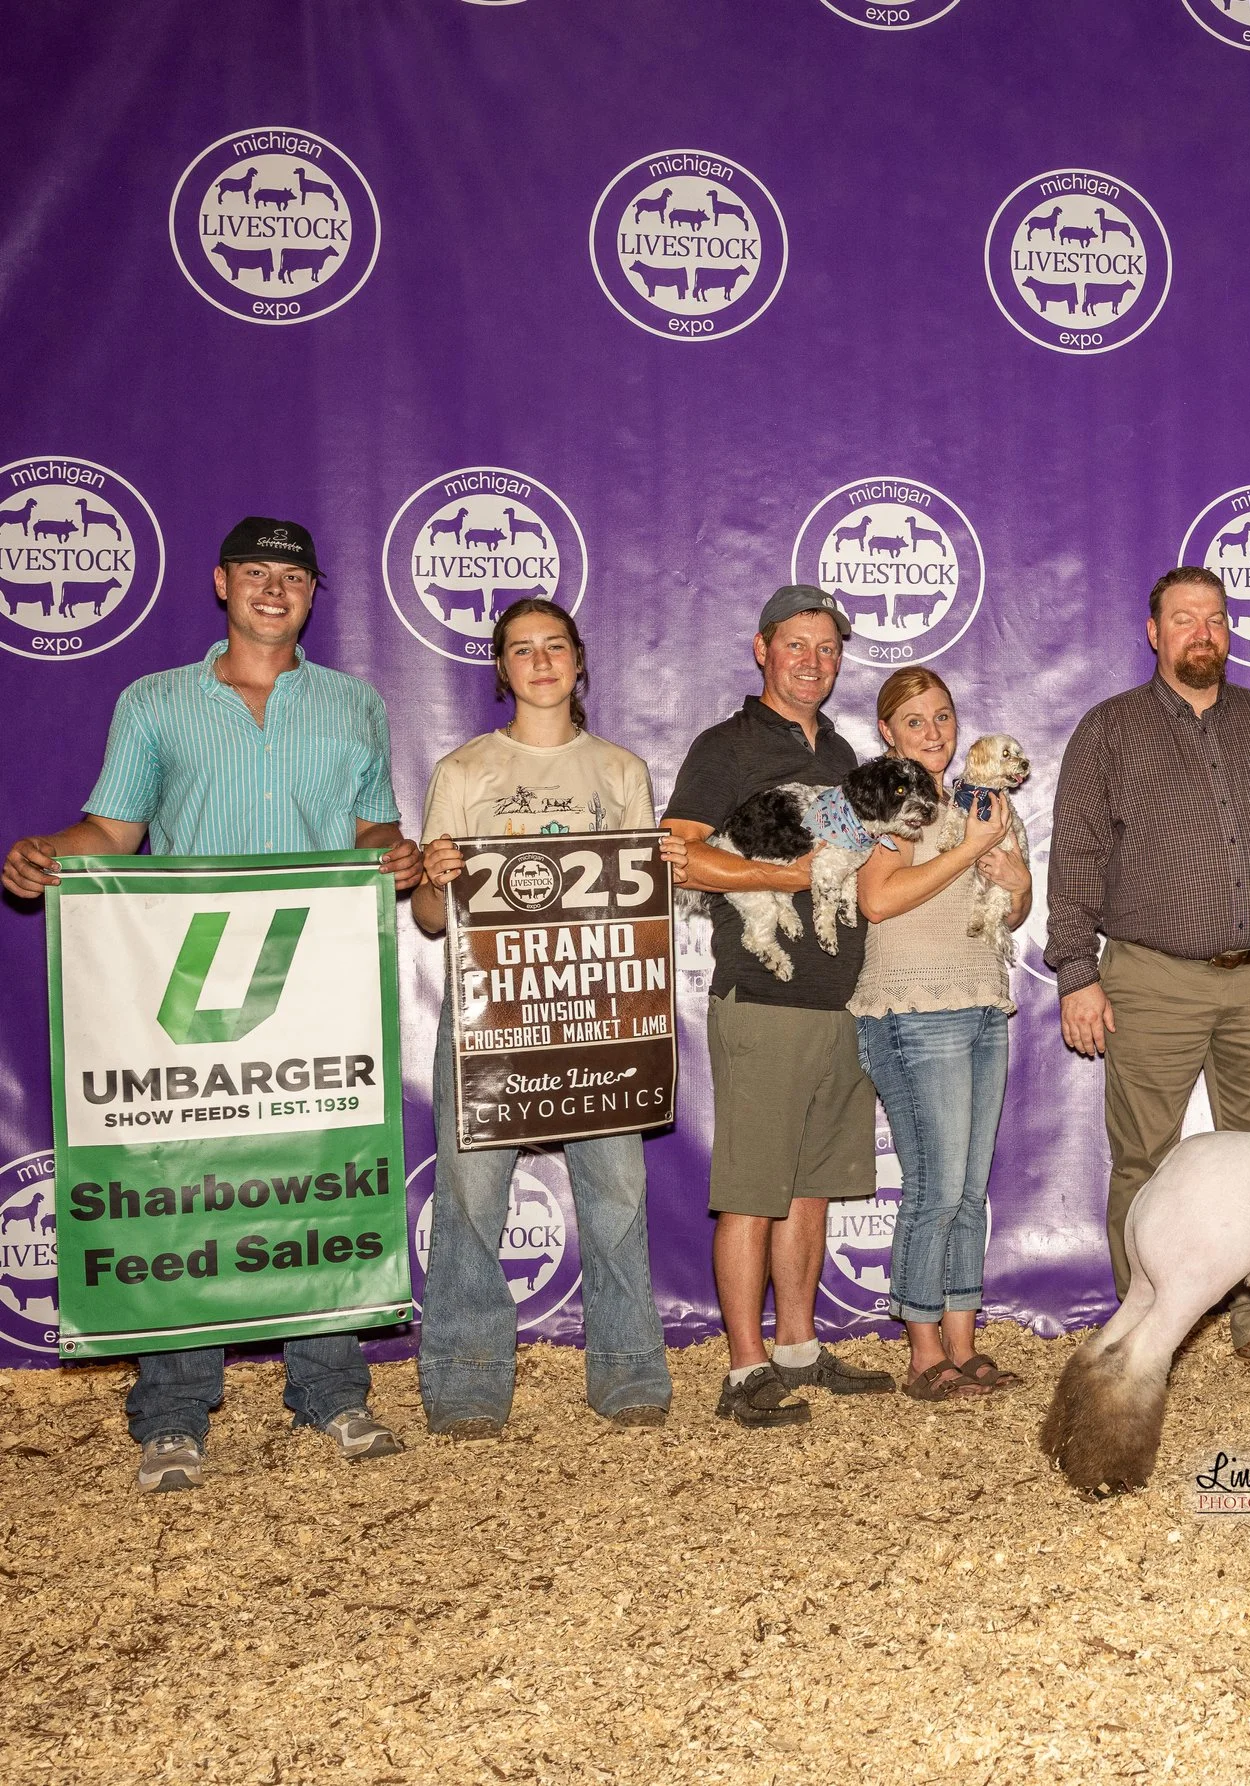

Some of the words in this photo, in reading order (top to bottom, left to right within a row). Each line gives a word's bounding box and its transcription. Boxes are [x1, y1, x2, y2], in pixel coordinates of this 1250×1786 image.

[233, 132, 322, 158] michigan
[649, 155, 733, 181] michigan
[1040, 174, 1119, 200] michigan
[202, 213, 349, 242] LIVESTOCK
[620, 233, 759, 260] LIVESTOCK
[1013, 250, 1143, 275] LIVESTOCK
[252, 301, 300, 320] expo
[668, 318, 714, 337] expo
[1060, 332, 1103, 350] expo
[11, 462, 105, 488] michigan
[444, 471, 531, 498] michigan
[849, 481, 931, 507] michigan
[415, 555, 556, 580] LIVESTOCK
[822, 561, 955, 585] LIVESTOCK
[32, 636, 82, 655] expo
[465, 641, 496, 660] exp
[869, 645, 913, 662] expo
[517, 853, 545, 863] michigan
[510, 877, 553, 888] LIVESTOCK
[495, 923, 635, 966] GRAND
[464, 957, 666, 1003] CHAMPION
[521, 999, 596, 1025] DIVISION
[464, 1025, 551, 1051] CROSSBRED
[563, 1019, 621, 1043] MARKET
[633, 1014, 667, 1037] LAMB
[82, 1054, 376, 1105] UMBARGER
[505, 1073, 564, 1095] State
[566, 1068, 618, 1089] Line
[104, 1109, 173, 1127] SHOW
[181, 1104, 250, 1123] FEEDS
[271, 1101, 309, 1116] EST.
[316, 1096, 359, 1112] 1939
[475, 1087, 664, 1124] CRYOGENICS
[69, 1157, 390, 1222] Sharbowski
[84, 1239, 218, 1287] Feed
[235, 1229, 383, 1273] Sales
